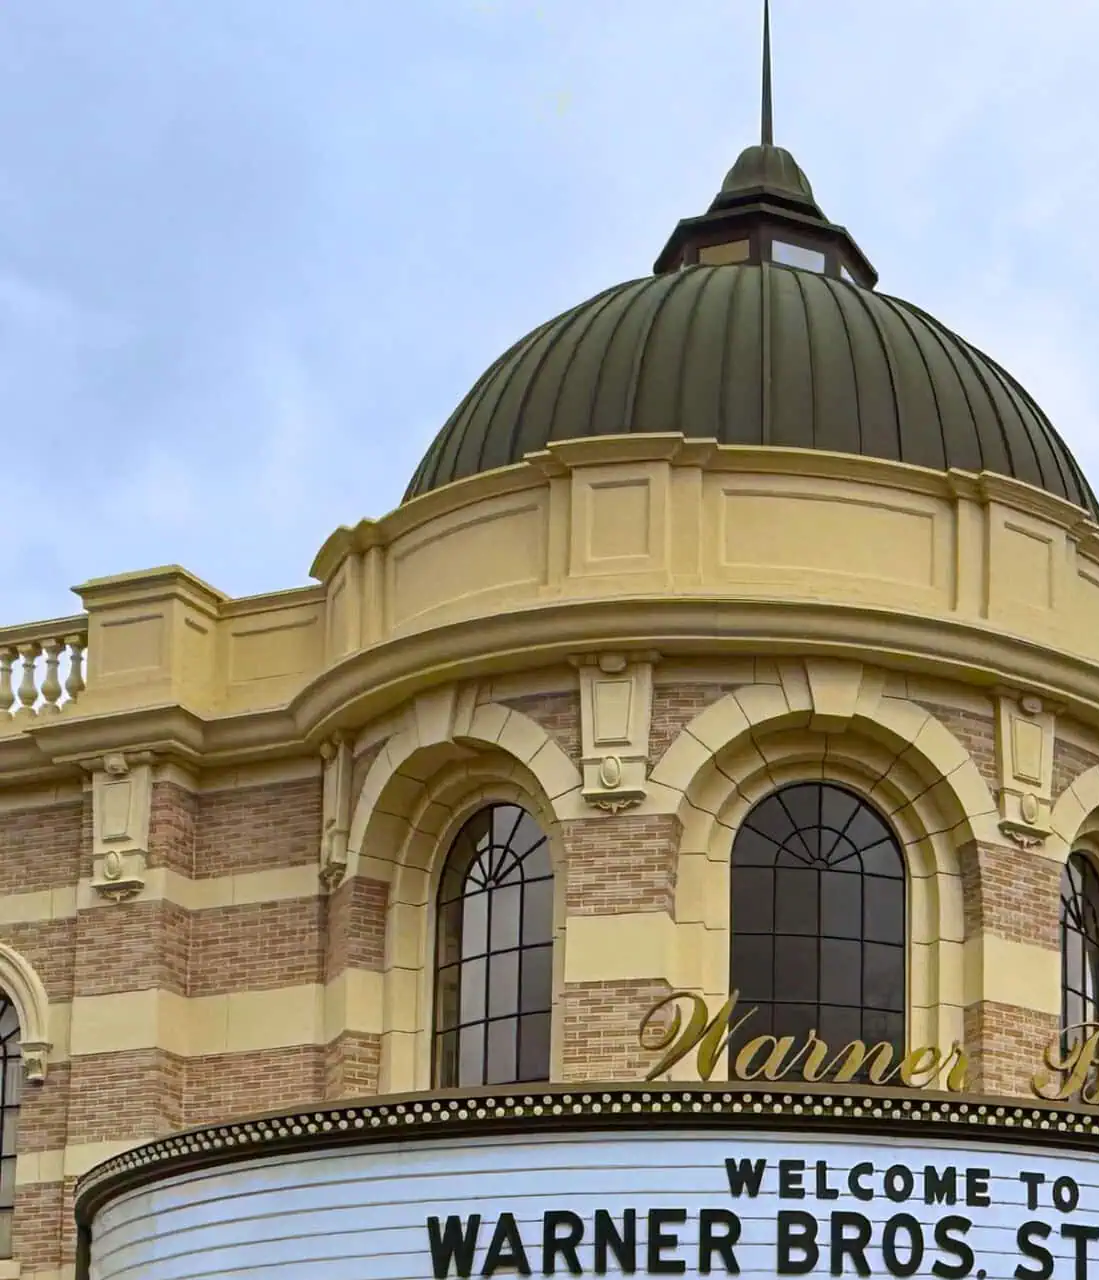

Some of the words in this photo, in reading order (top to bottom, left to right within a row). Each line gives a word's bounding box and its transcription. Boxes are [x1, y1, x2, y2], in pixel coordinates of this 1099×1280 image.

[639, 989, 969, 1092] Warner
[725, 1157, 990, 1206] WELCOME
[1019, 1171, 1079, 1212] TO
[427, 1208, 742, 1279] WARNER
[777, 1209, 987, 1280] BROS.
